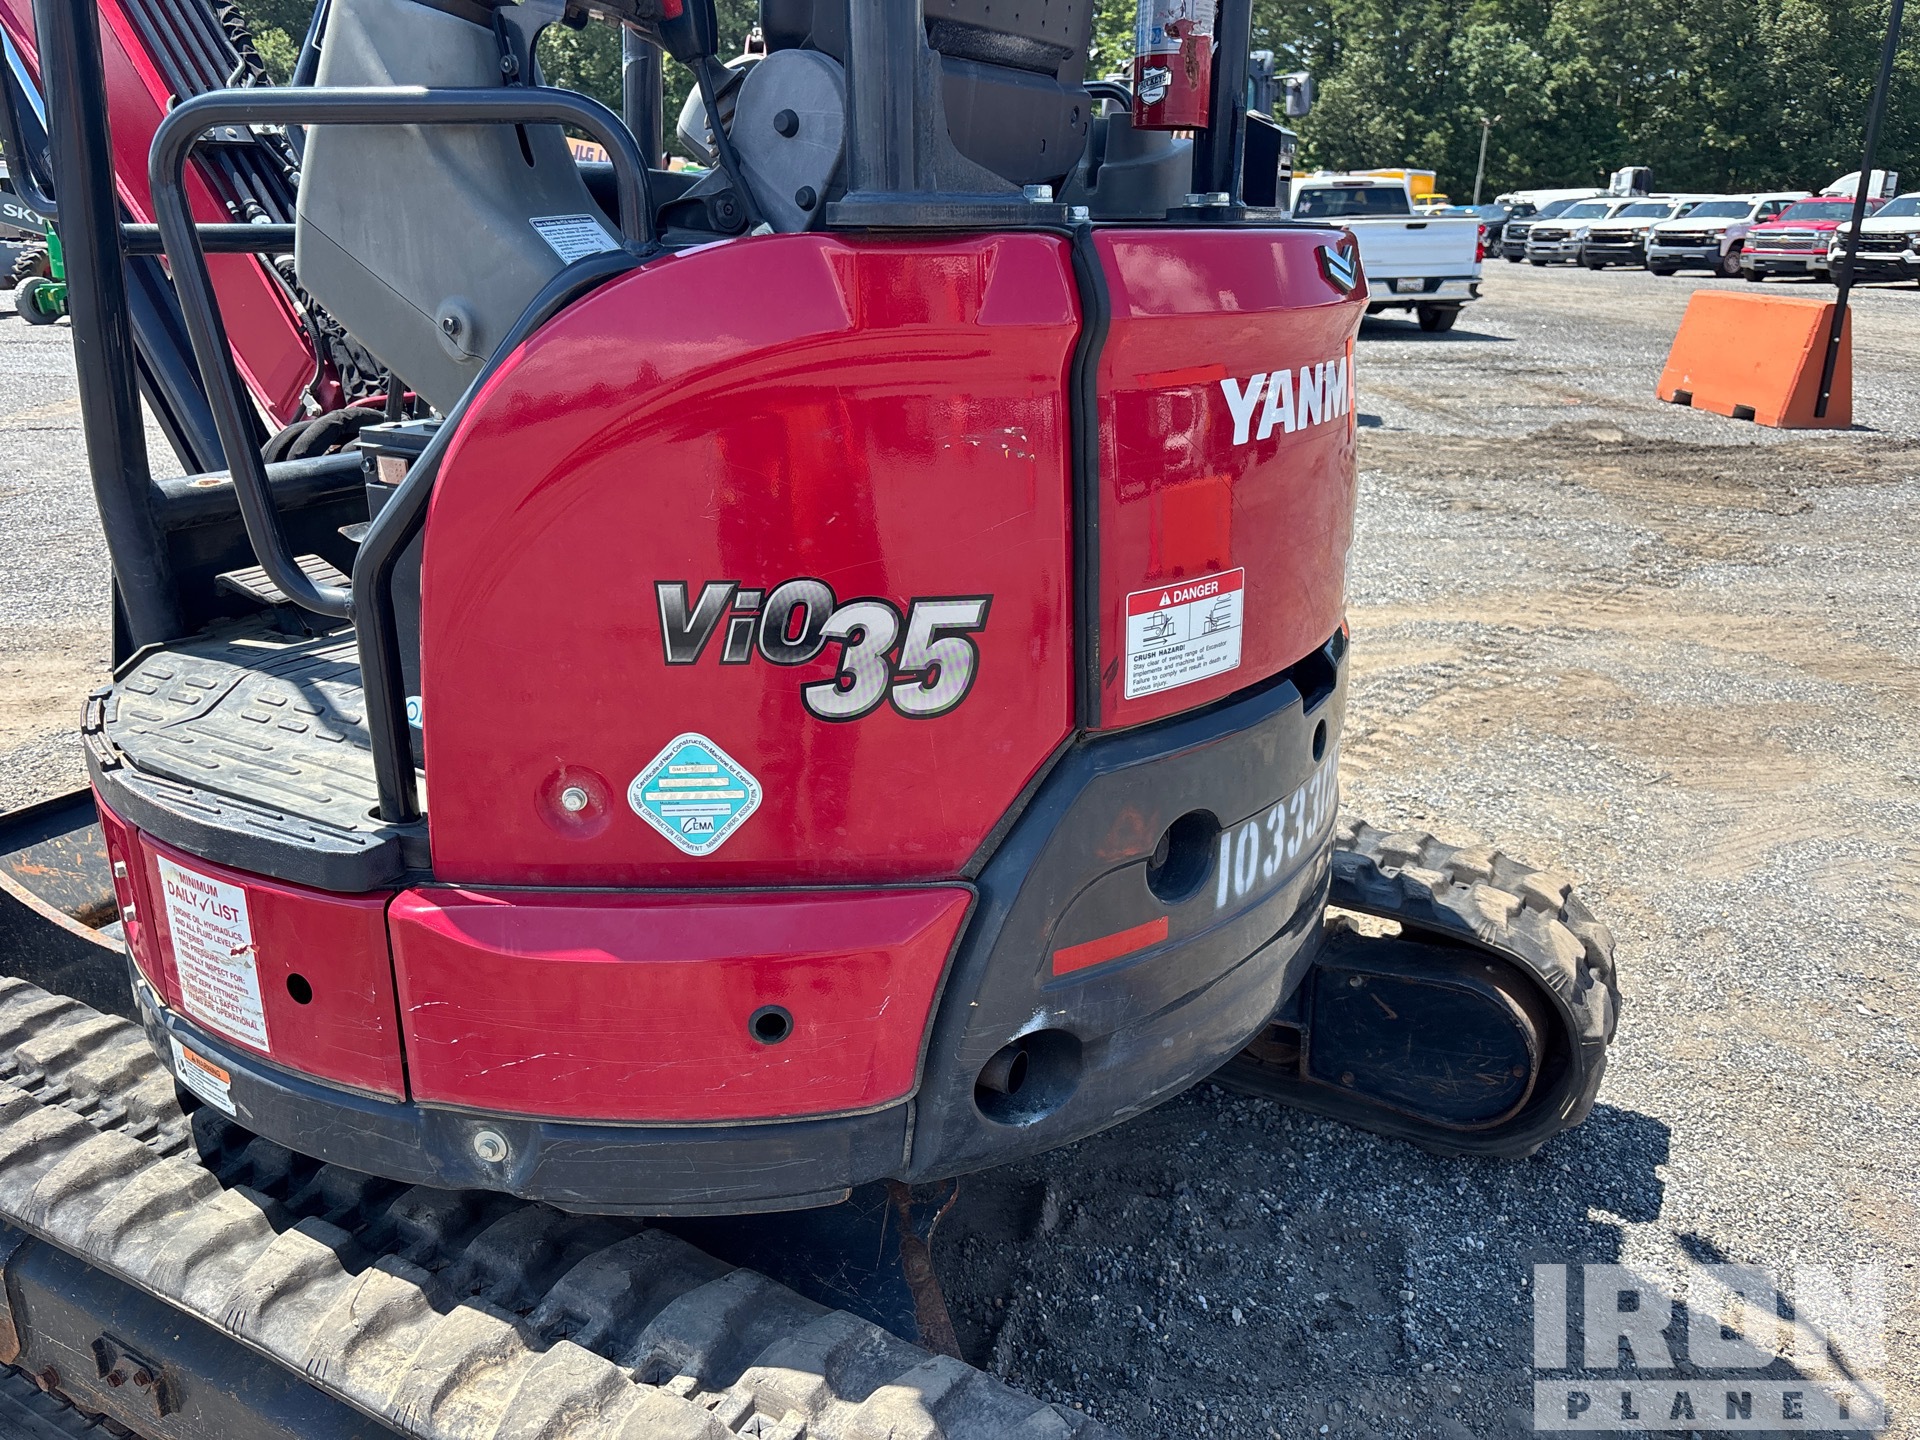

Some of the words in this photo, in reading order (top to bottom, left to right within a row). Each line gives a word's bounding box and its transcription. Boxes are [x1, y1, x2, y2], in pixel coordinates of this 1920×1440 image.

[574, 144, 594, 162] JLG
[1173, 580, 1219, 604] DANGER
[1133, 652, 1157, 662] CRUSH
[1158, 644, 1186, 656] HAZARD!
[1146, 660, 1160, 668] clear
[1168, 654, 1183, 662] swing
[1206, 640, 1227, 652] Excavator
[1175, 658, 1196, 668] machine
[1132, 677, 1150, 686] Failure
[1160, 670, 1178, 680] comply
[1188, 662, 1202, 671] result
[1208, 656, 1222, 665] death
[1132, 684, 1151, 694] serious
[636, 766, 660, 790] Certificate
[658, 760, 665, 768] of
[662, 752, 674, 763] New
[672, 738, 710, 753] Construction
[708, 748, 730, 768] Machine
[728, 764, 736, 774] for
[735, 770, 754, 788] Export
[634, 792, 644, 809] JAPAN
[642, 808, 675, 836] CONSTRUCTION
[674, 834, 703, 852] EQUIPMENT
[706, 816, 740, 848] MANUFACTURERS
[738, 788, 758, 818] ASSOCIATION
[682, 817, 714, 834] CEMA
[178, 871, 218, 898] MINIMUM
[167, 880, 198, 907] DAILY
[210, 900, 239, 923] LIST
[175, 917, 186, 926] AND
[186, 922, 196, 933] ALL
[196, 926, 212, 940] FLUID
[176, 926, 204, 946] BATTERIES
[204, 920, 245, 943] HYDRAULICS,
[178, 937, 190, 950] TIRE
[190, 944, 220, 964] PRESSURE
[180, 948, 204, 966] VISUALLY
[204, 961, 228, 978] INSPECT
[230, 972, 246, 985] FOR:
[213, 986, 240, 1002] FITTINGS
[216, 978, 234, 990] BROKEN
[234, 985, 249, 995] PARTS
[208, 992, 220, 1004] ALL
[220, 998, 243, 1015] SAFETY
[204, 1000, 216, 1012] ARE
[216, 1006, 260, 1032] OPERATIONAL
